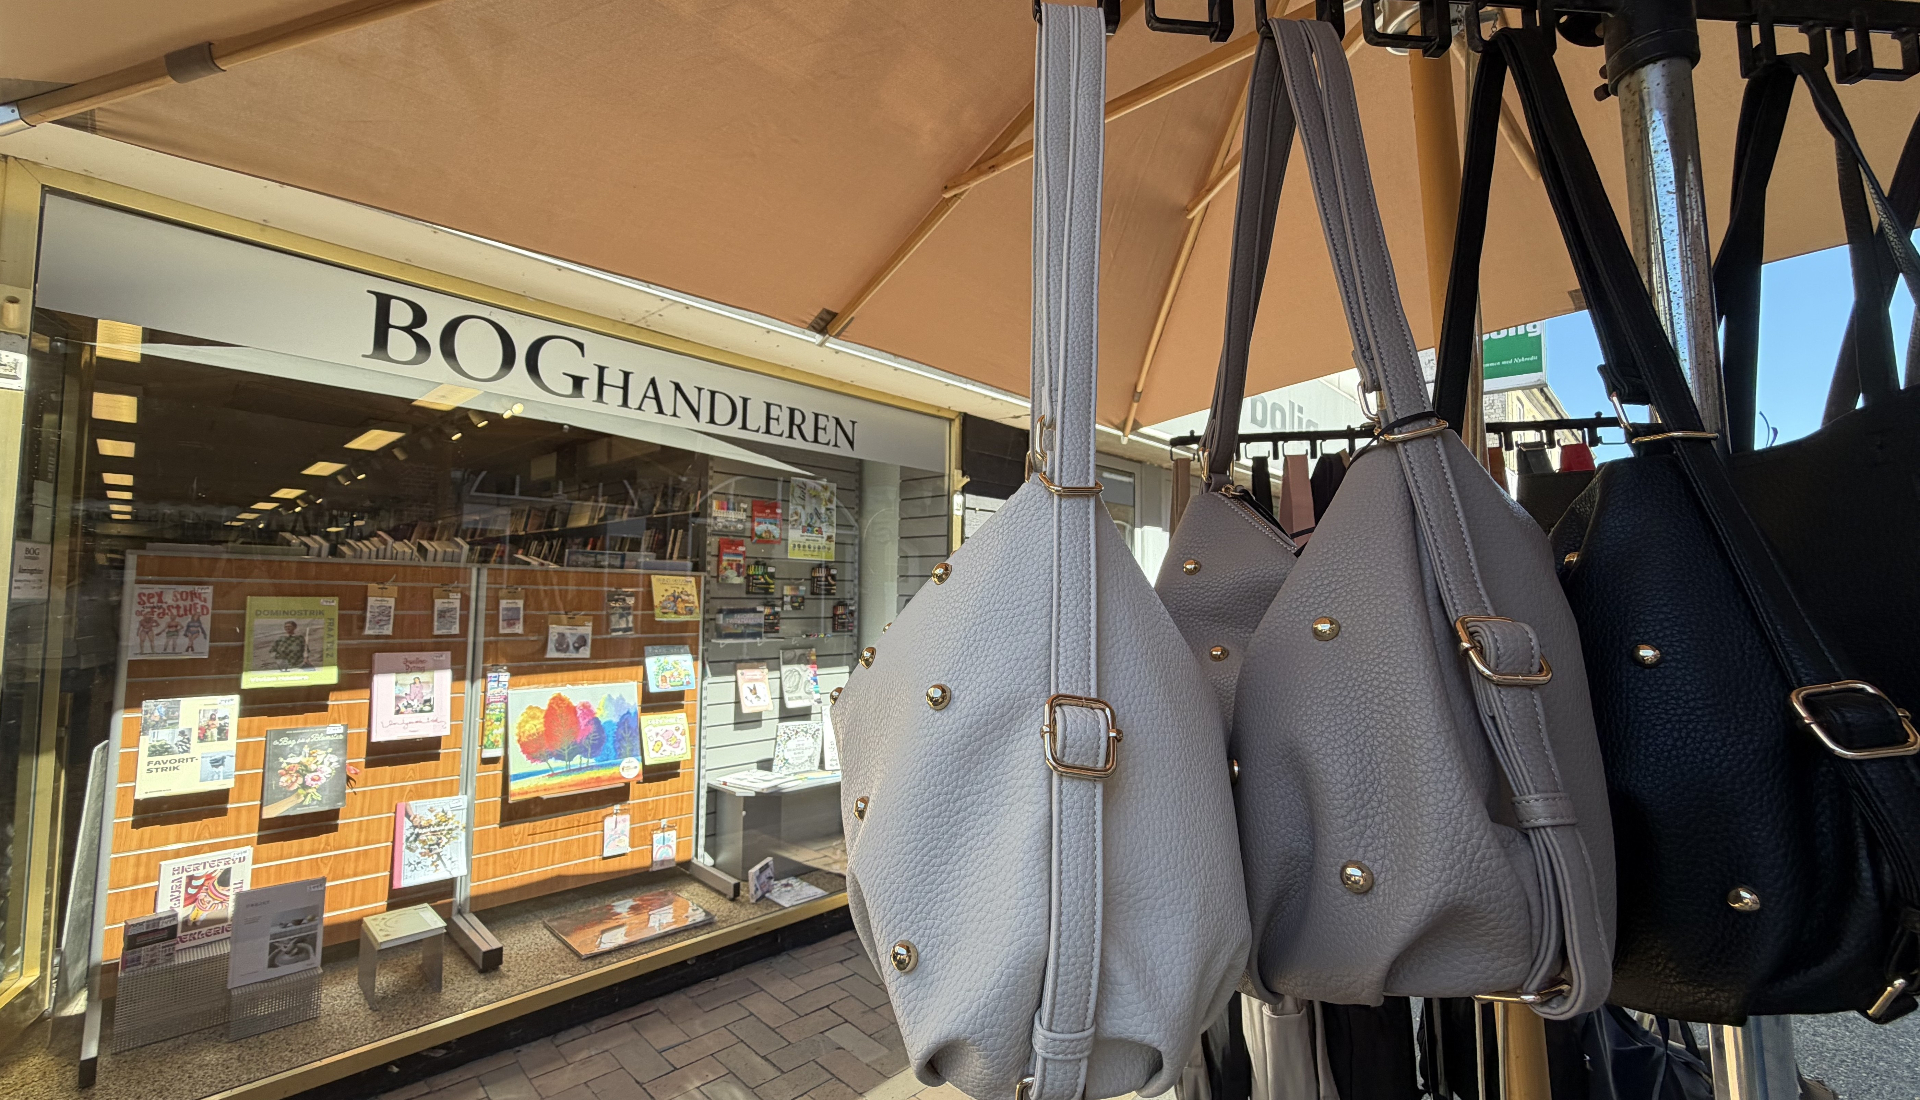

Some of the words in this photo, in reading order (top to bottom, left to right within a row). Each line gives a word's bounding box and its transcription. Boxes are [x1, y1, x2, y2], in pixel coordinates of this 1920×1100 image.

[254, 609, 325, 617] DOMINOSTRIK
[146, 756, 199, 767] FAVORIT-
[146, 765, 180, 774] STRIK
